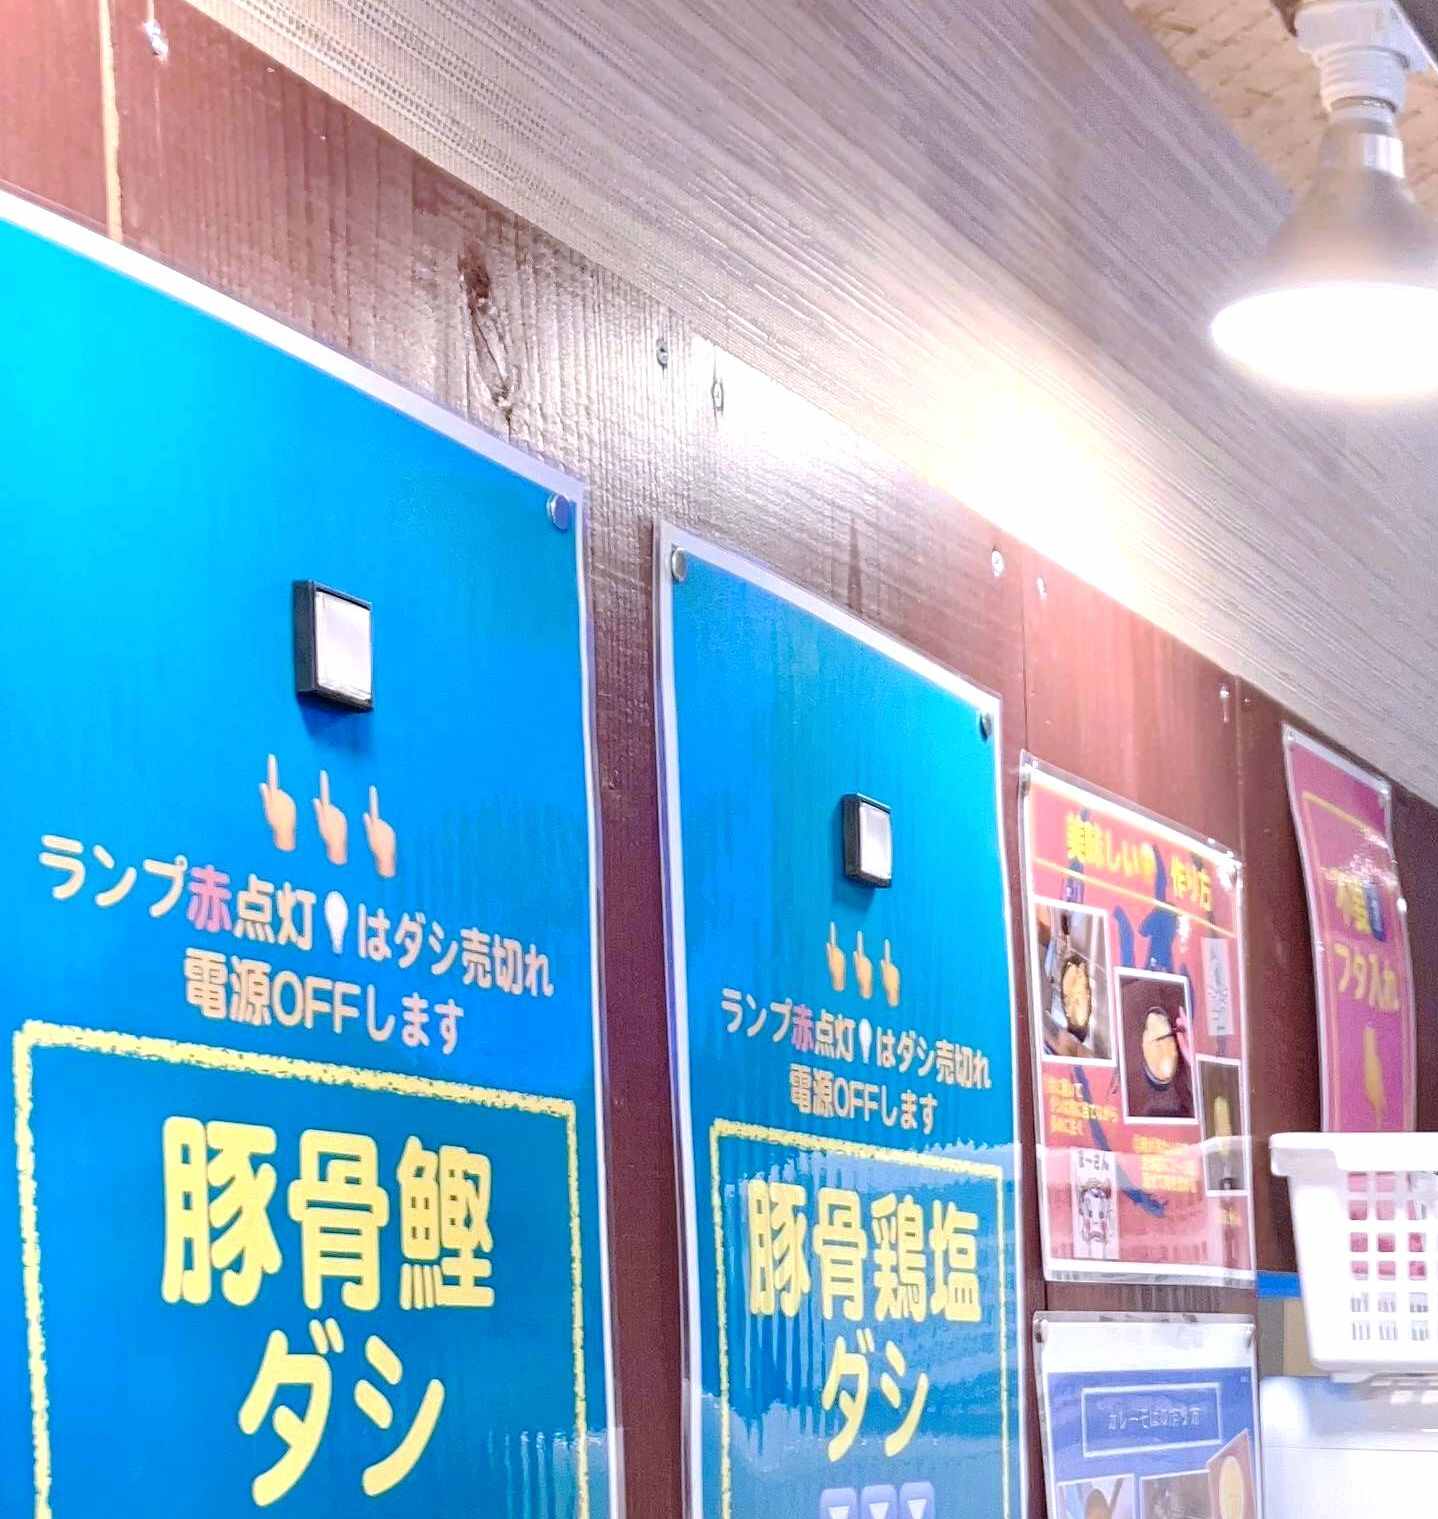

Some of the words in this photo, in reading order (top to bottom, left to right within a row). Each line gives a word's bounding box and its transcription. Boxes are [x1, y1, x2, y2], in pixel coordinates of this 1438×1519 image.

[183, 947, 465, 1056] 電源OFFします
[789, 1062, 939, 1136] 電源OFFします
[161, 1114, 496, 1311] 豚骨鰹
[746, 1178, 983, 1323] 豚骨鶏塩
[237, 1317, 446, 1508] ダシ
[821, 1327, 929, 1463] ダシ
